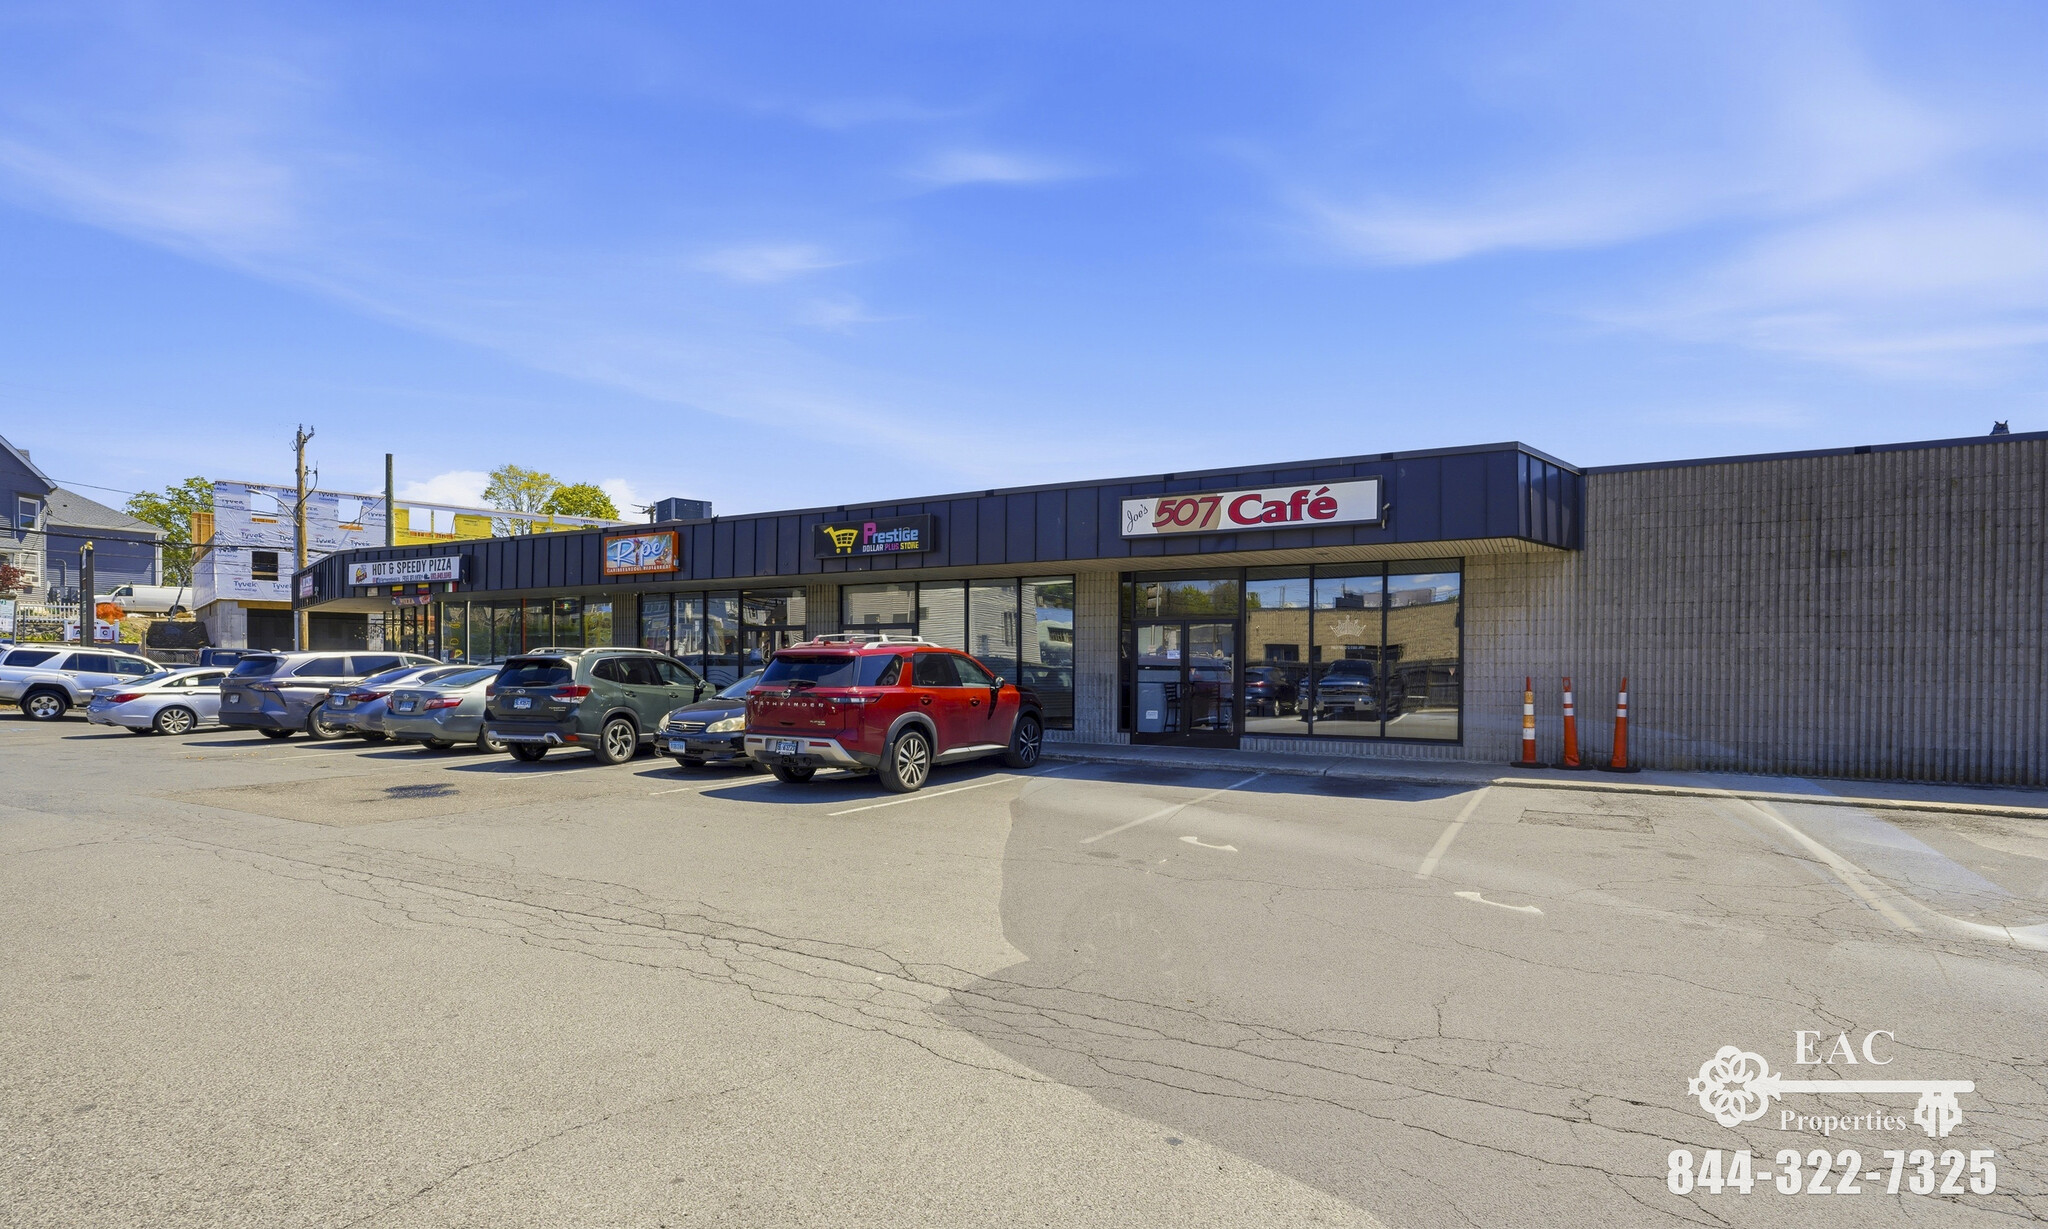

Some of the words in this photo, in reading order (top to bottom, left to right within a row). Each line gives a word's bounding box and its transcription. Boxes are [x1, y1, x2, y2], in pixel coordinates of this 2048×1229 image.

[1126, 504, 1149, 533] Joe's
[1152, 495, 1224, 528] 507
[1227, 485, 1338, 525] Café
[862, 543, 884, 553] DOLLAR
[884, 542, 899, 551] PLUS
[900, 541, 919, 550] STORE
[372, 563, 386, 576] HOT
[389, 562, 394, 574] &
[396, 559, 427, 574] SPEEDY
[429, 558, 452, 571] PIZZA
[233, 580, 257, 588] Tyvek
[272, 582, 292, 590] Tyve
